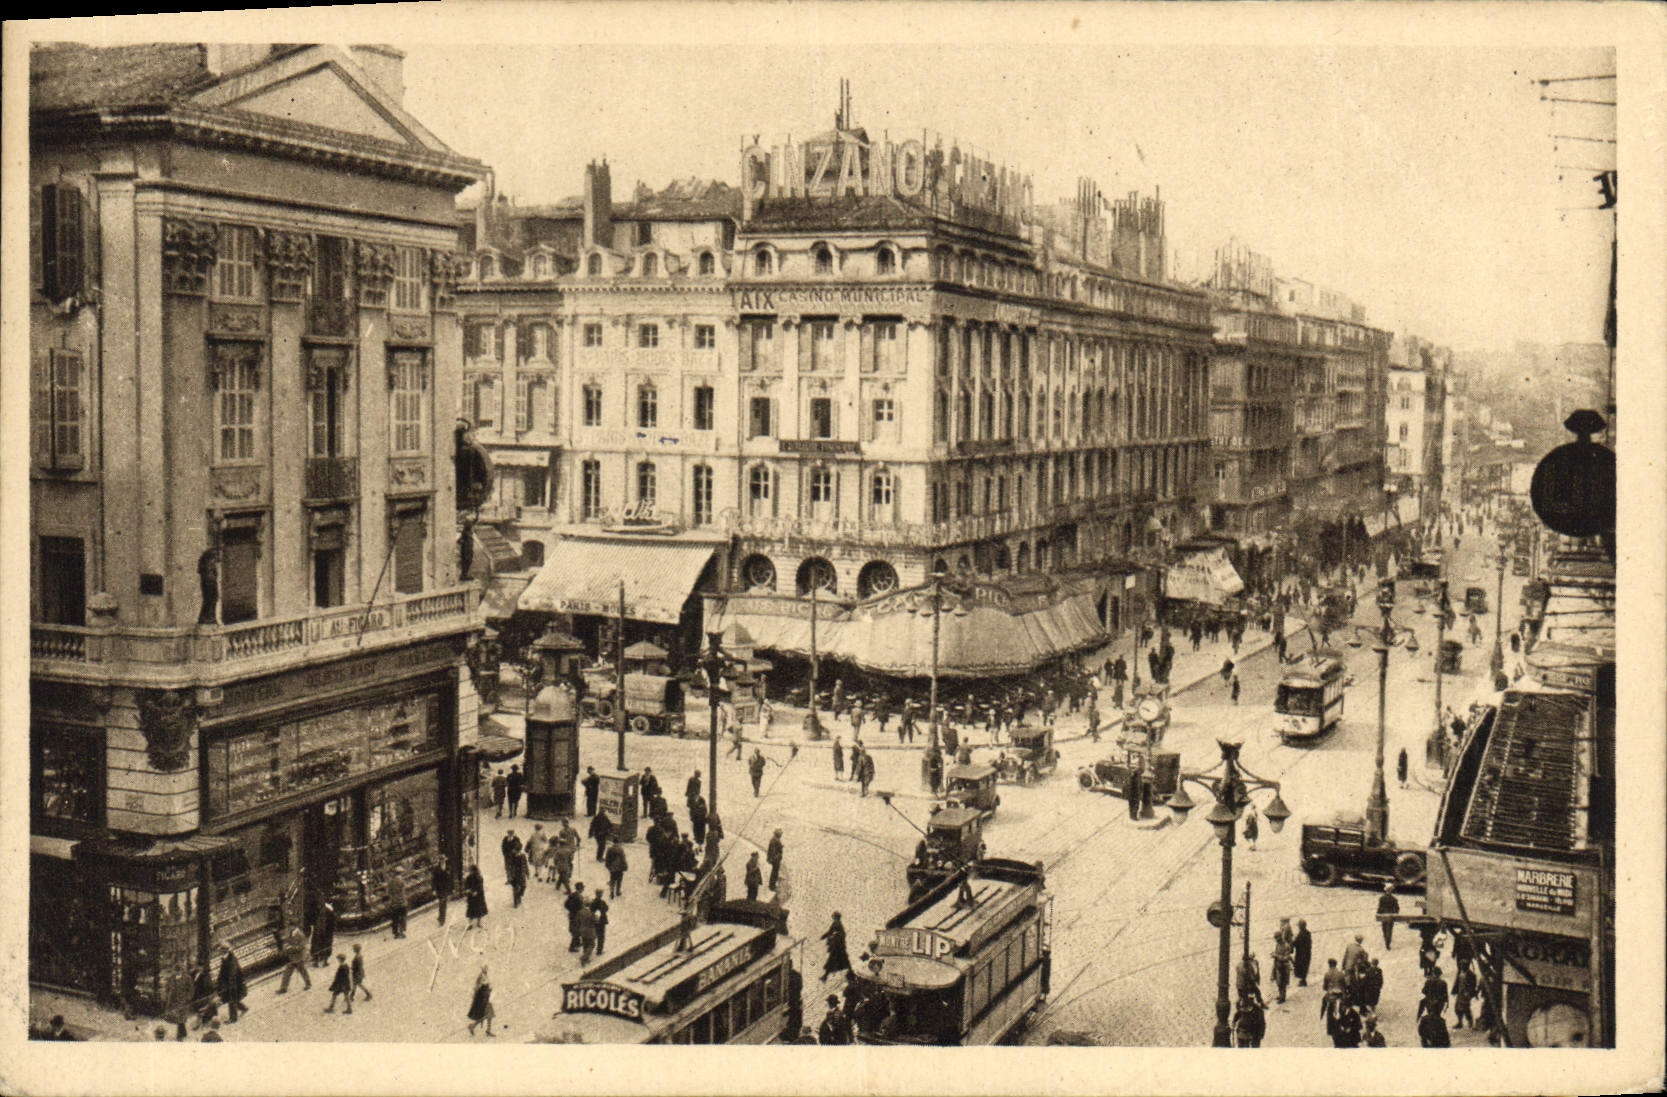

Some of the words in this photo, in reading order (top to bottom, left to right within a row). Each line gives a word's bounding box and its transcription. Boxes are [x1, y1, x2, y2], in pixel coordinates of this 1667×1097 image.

[742, 139, 925, 198] CINZANO
[740, 289, 775, 309] AIX
[779, 289, 834, 302] CASINO
[840, 288, 922, 303] MUNICIPAL
[1517, 870, 1574, 889] MARBRERIE
[913, 931, 951, 958] LIP
